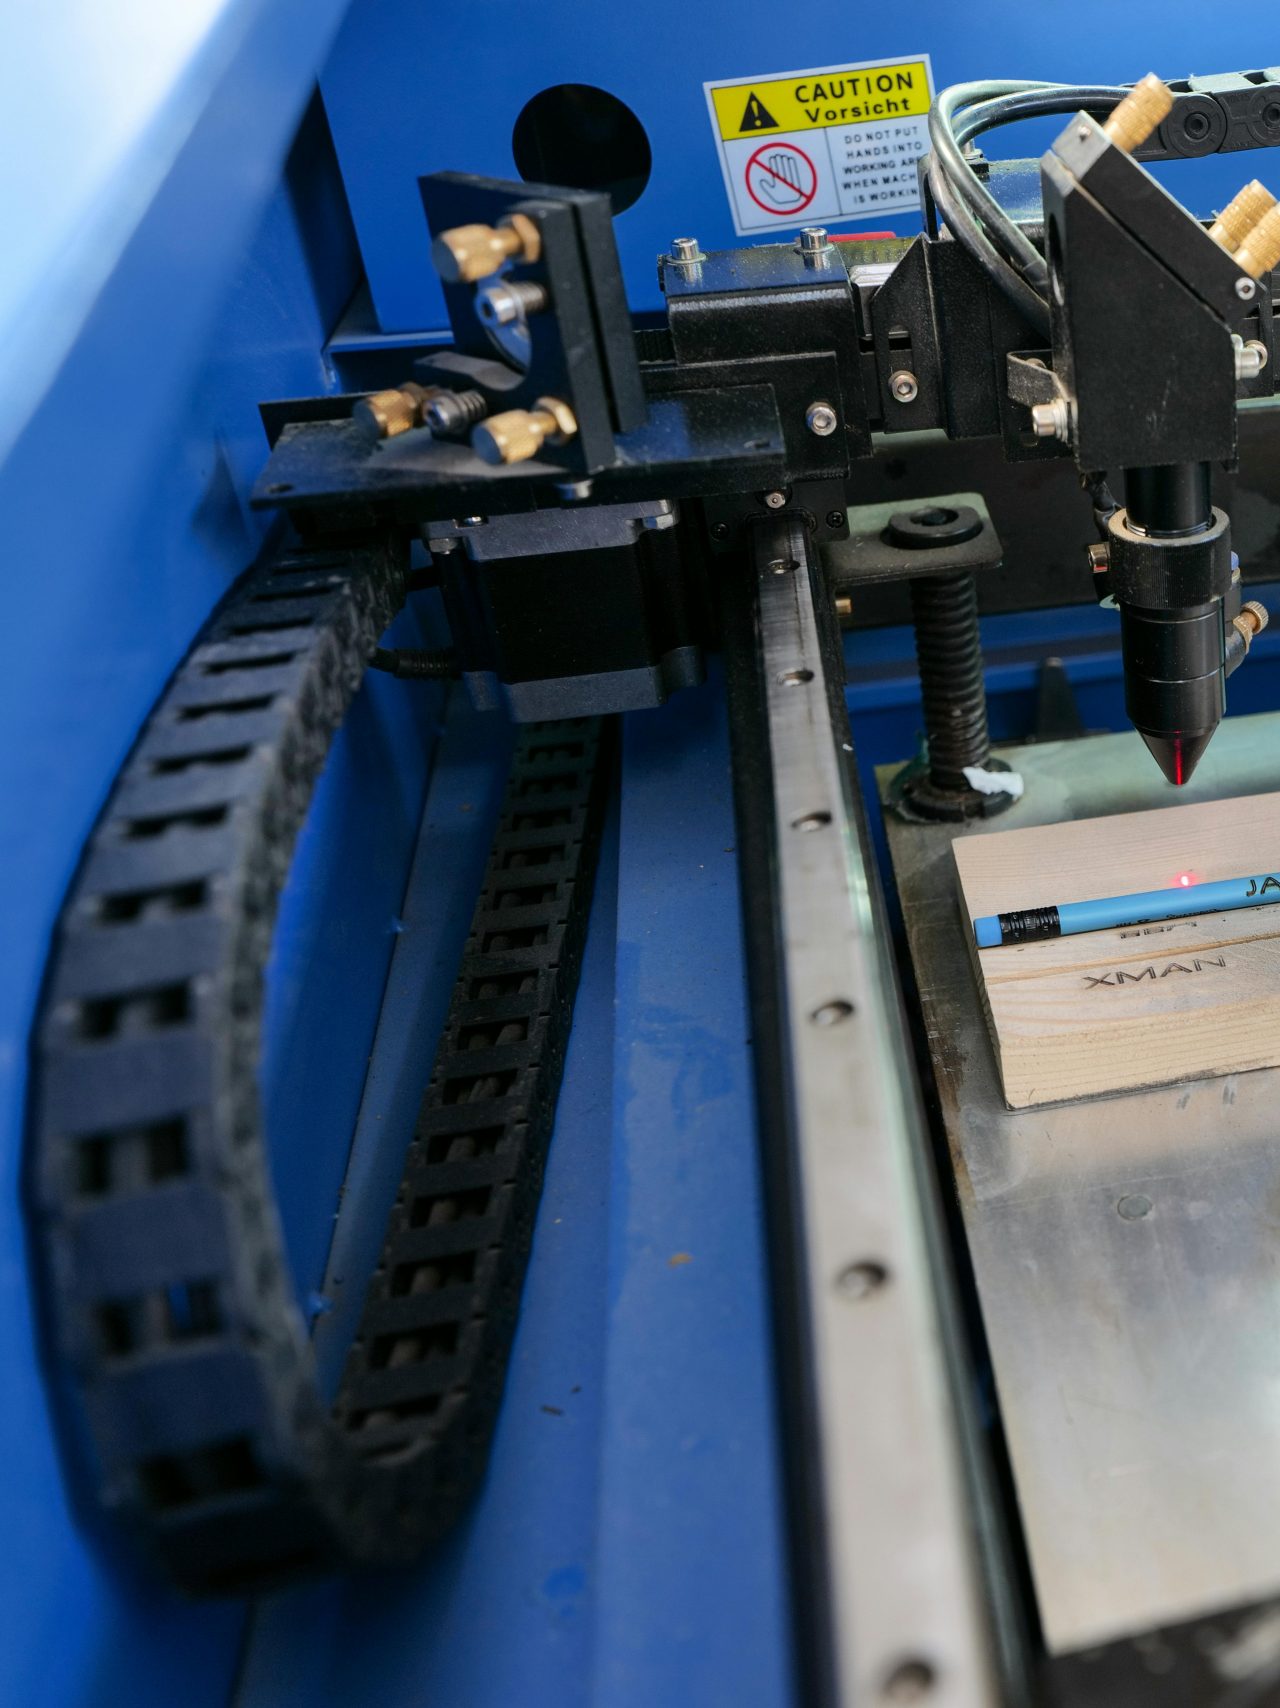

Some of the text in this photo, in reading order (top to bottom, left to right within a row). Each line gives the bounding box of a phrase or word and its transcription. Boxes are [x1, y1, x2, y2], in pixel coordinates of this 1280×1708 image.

[795, 72, 913, 103] CAUTION
[805, 98, 910, 123] Vorsicht
[844, 126, 918, 144] DO NOT PUT
[847, 141, 922, 159] HANDS INTO
[843, 160, 896, 175] WORKING
[842, 173, 916, 190] WHEN MACH
[854, 188, 918, 204] IS WORKIN
[1082, 955, 1226, 990] XMAN
